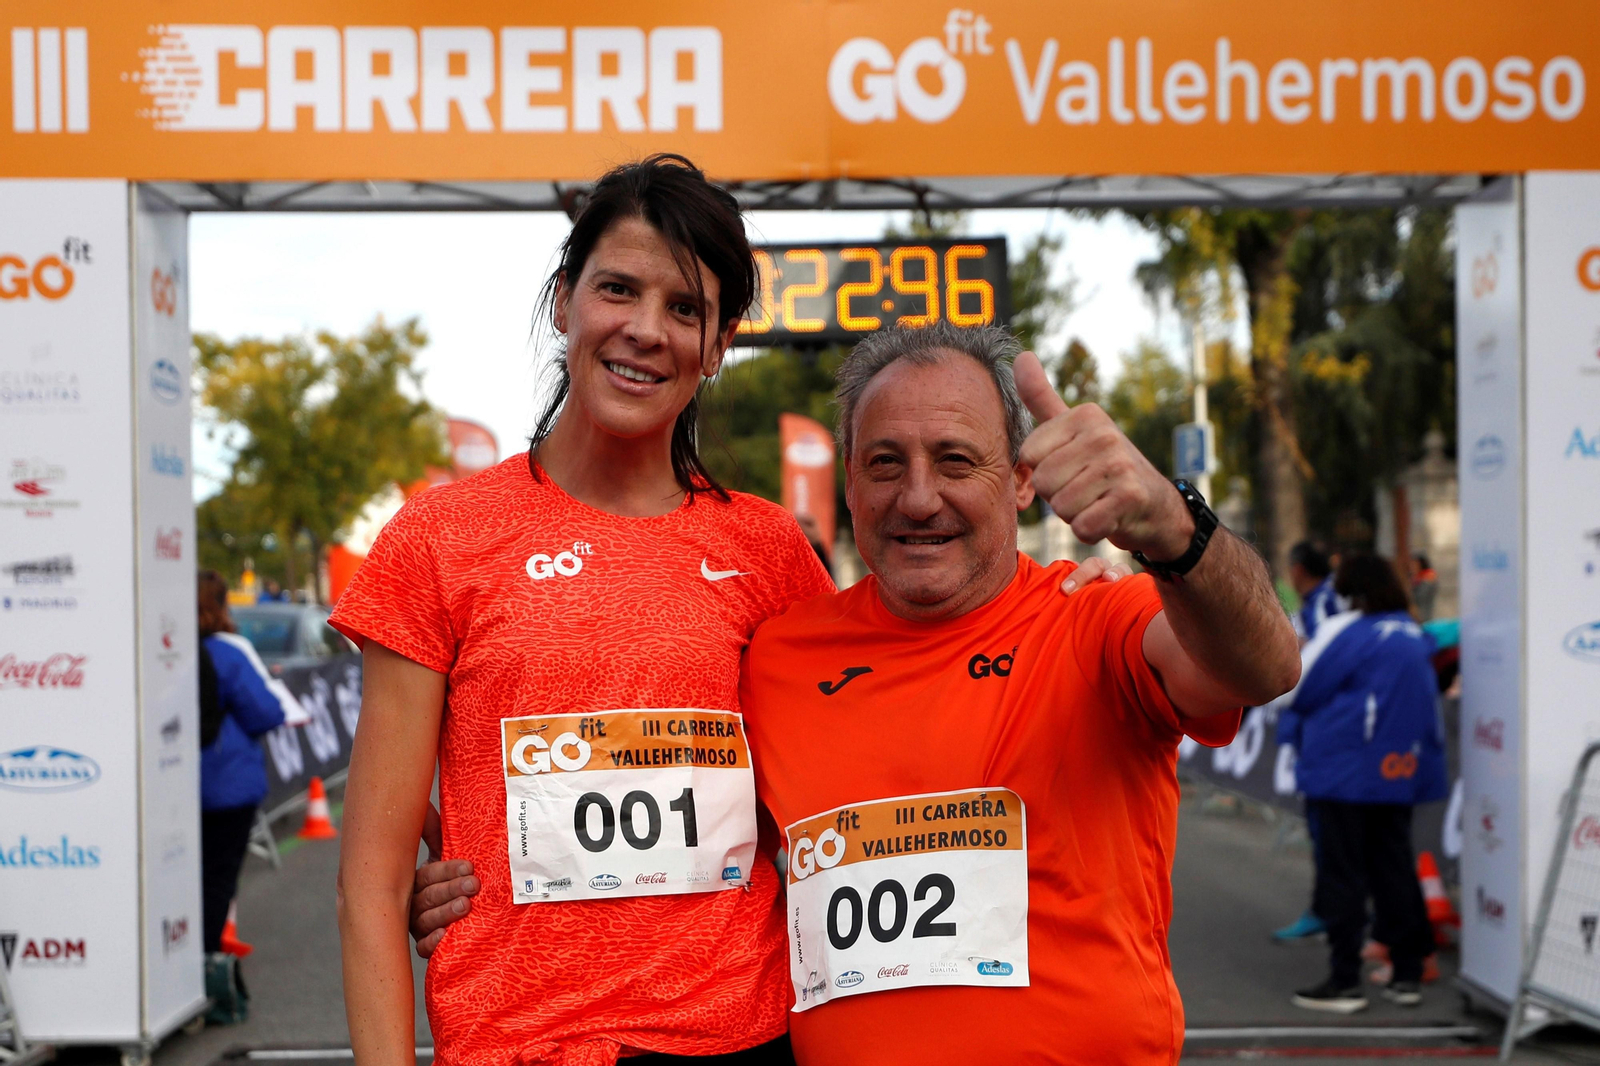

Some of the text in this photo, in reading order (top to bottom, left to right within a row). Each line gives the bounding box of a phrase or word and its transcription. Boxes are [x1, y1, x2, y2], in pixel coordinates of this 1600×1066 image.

[12, 24, 723, 132] III CARRERA
[827, 8, 993, 124] GO fit
[1004, 36, 1586, 126] Vallehermoso
[0, 237, 92, 300] GO fit
[525, 541, 593, 580] GO fit
[511, 718, 607, 775] GO fit
[642, 719, 737, 738] III CARRERA
[610, 748, 738, 767] VALLEHERMOSO
[518, 800, 529, 857] www.gofit.es
[574, 787, 698, 853] 001
[895, 799, 1008, 825] III CARRERA
[791, 810, 861, 880] GO fit
[862, 829, 1008, 858] VALLEHERMOSO
[826, 873, 957, 950] 002
[21, 937, 87, 960] ADM
